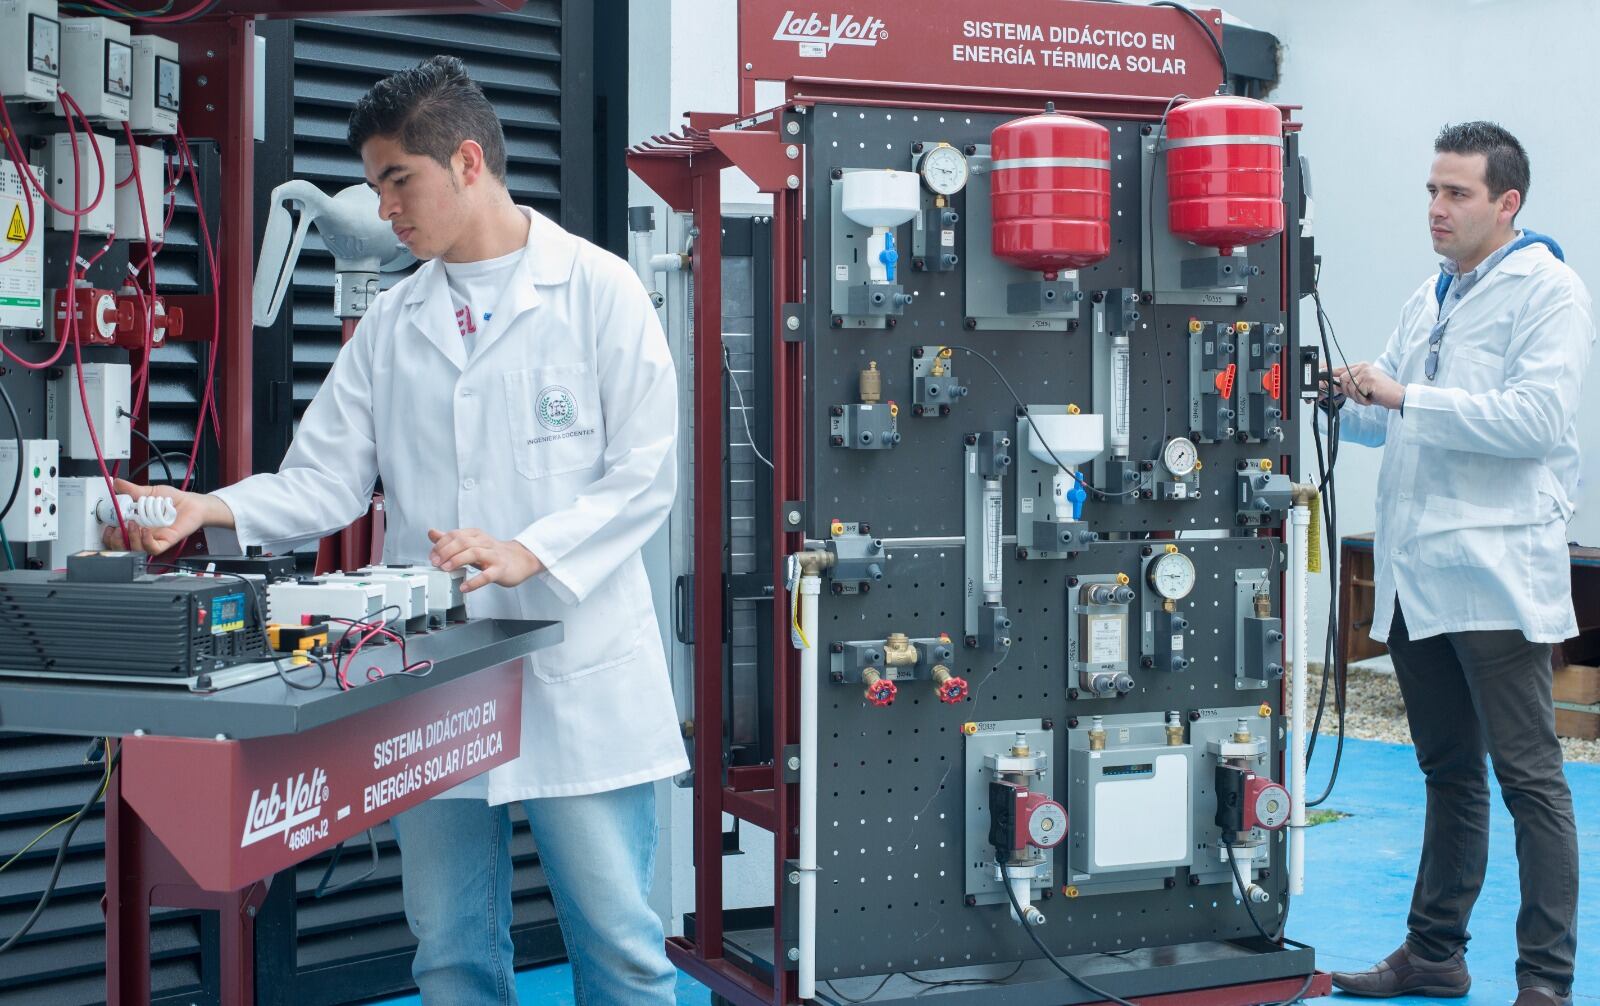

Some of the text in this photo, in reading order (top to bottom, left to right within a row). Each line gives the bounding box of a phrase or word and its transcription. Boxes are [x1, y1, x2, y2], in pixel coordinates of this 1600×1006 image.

[963, 20, 1175, 50] SISTEMA DIDÁCTICO EN
[952, 44, 1186, 75] ENERGÍA TÉRMICA SOLAR
[374, 699, 496, 770] SISTEMA DIDÁCTICO EN
[364, 761, 422, 814] ENERGÍAS
[424, 751, 459, 786] SOLAR
[467, 730, 503, 766] EÓLICA
[288, 818, 329, 852] 46801-J2
